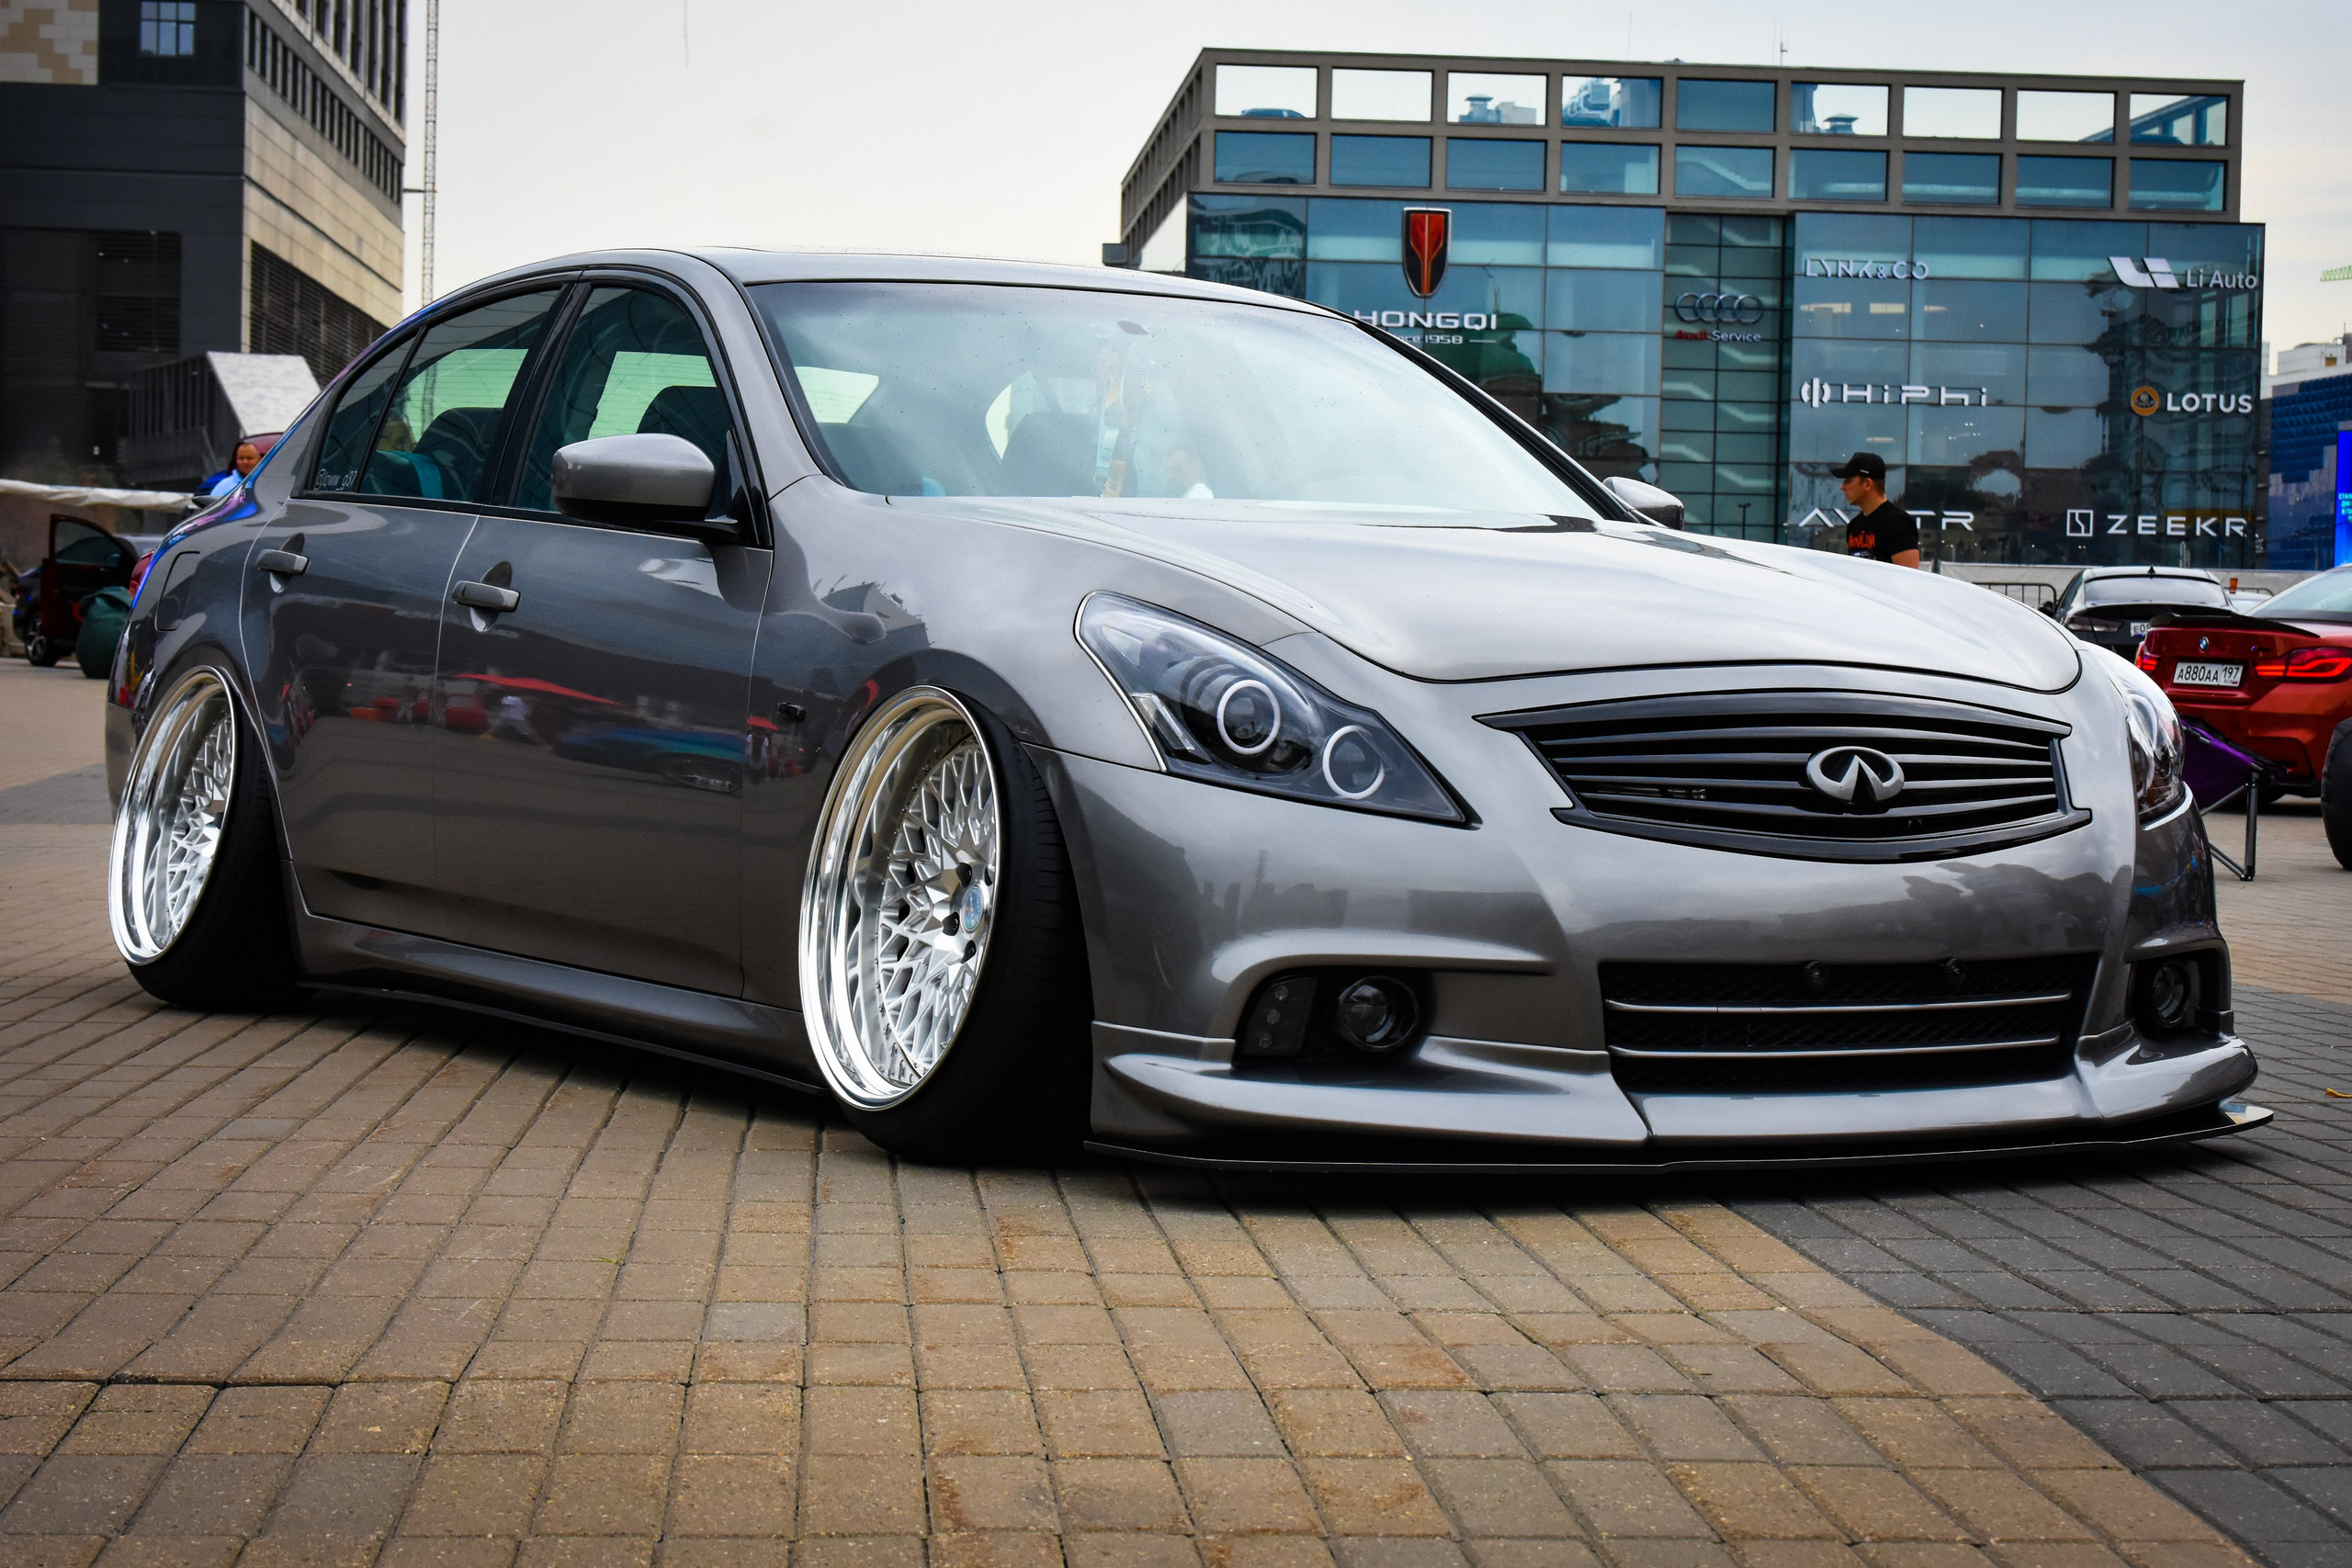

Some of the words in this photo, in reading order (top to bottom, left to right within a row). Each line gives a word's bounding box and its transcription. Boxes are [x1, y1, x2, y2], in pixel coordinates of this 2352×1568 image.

[2187, 268, 2203, 288] Li
[2209, 269, 2257, 289] Auto
[1353, 310, 1497, 331] HONGQI
[1425, 334, 1464, 345] 1958
[1712, 330, 1761, 342] Service
[2166, 392, 2253, 413] LOTUS
[1798, 507, 1974, 531] ATR
[2107, 513, 2247, 537] ZEEKR
[2177, 665, 2219, 682] A880AA
[2222, 666, 2240, 680] 197
